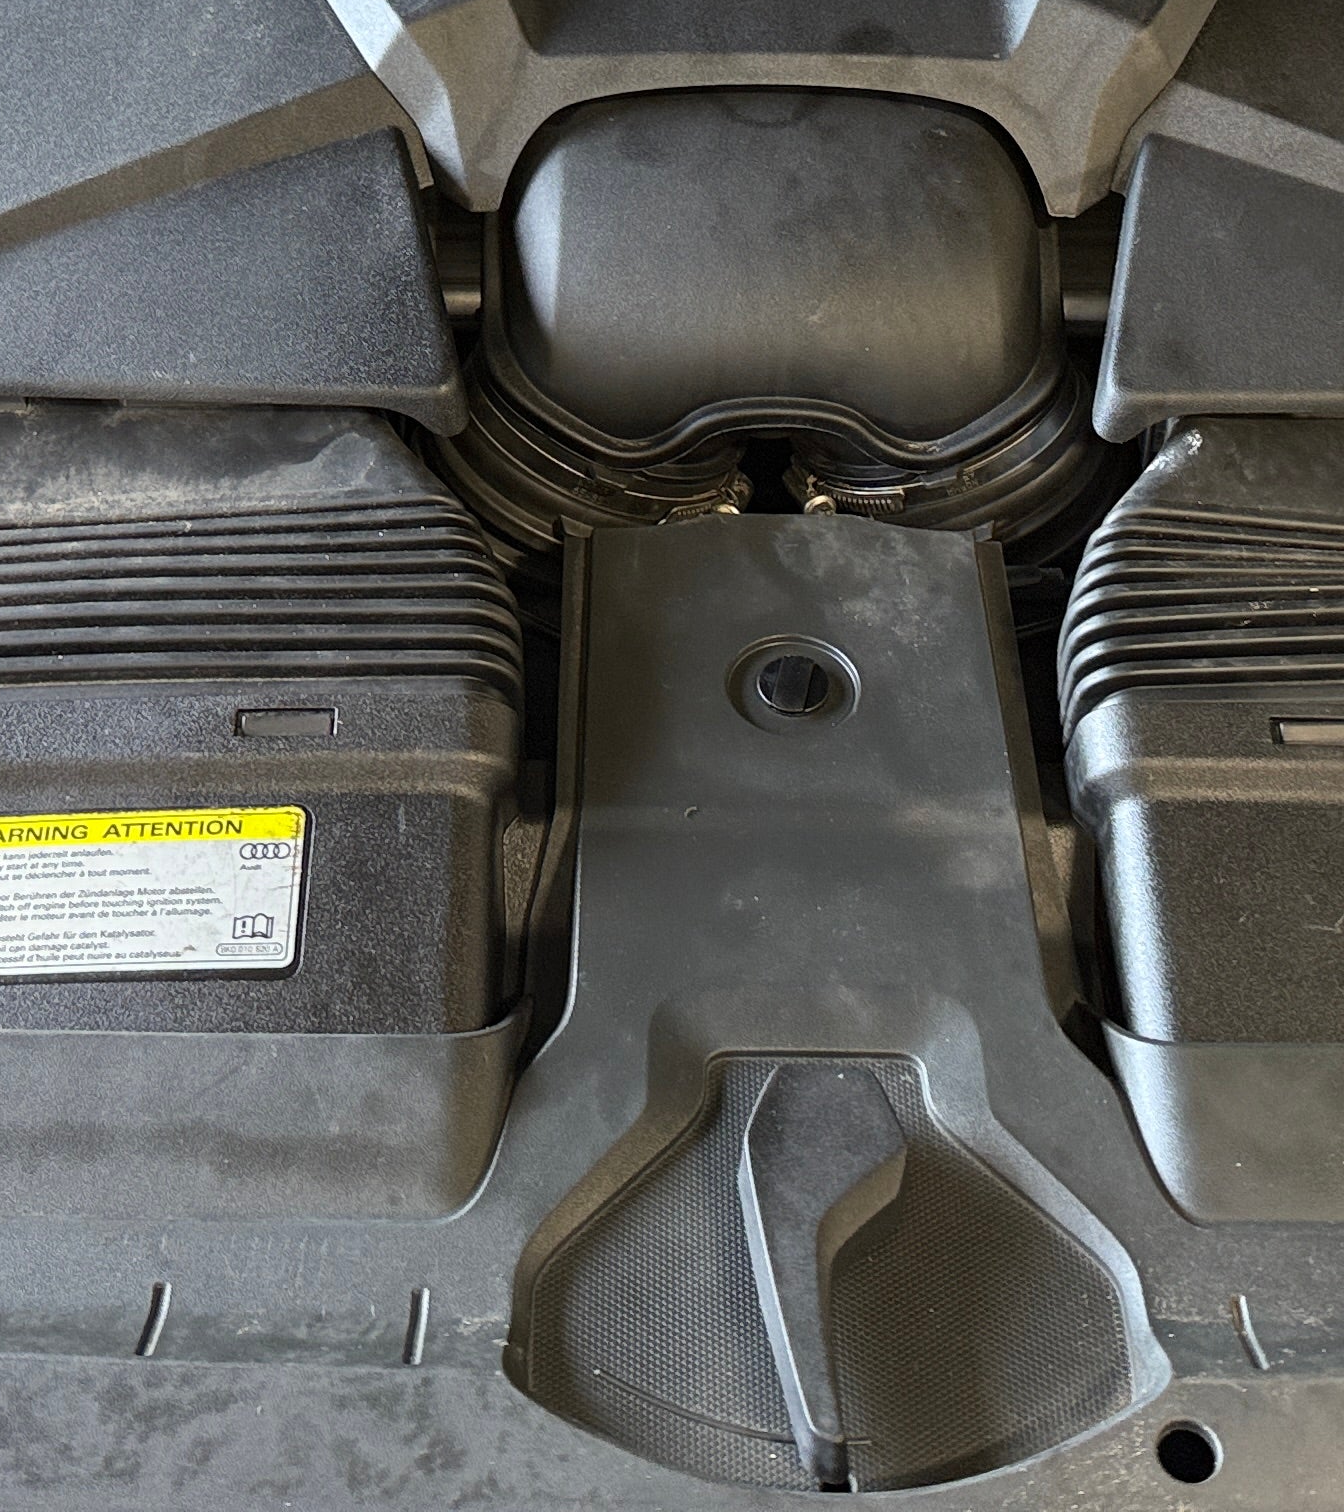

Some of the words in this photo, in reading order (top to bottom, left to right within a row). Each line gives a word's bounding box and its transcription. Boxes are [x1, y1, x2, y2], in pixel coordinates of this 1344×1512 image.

[102, 819, 242, 838] ATTENTION
[5, 862, 27, 870] start
[32, 901, 66, 911] engine
